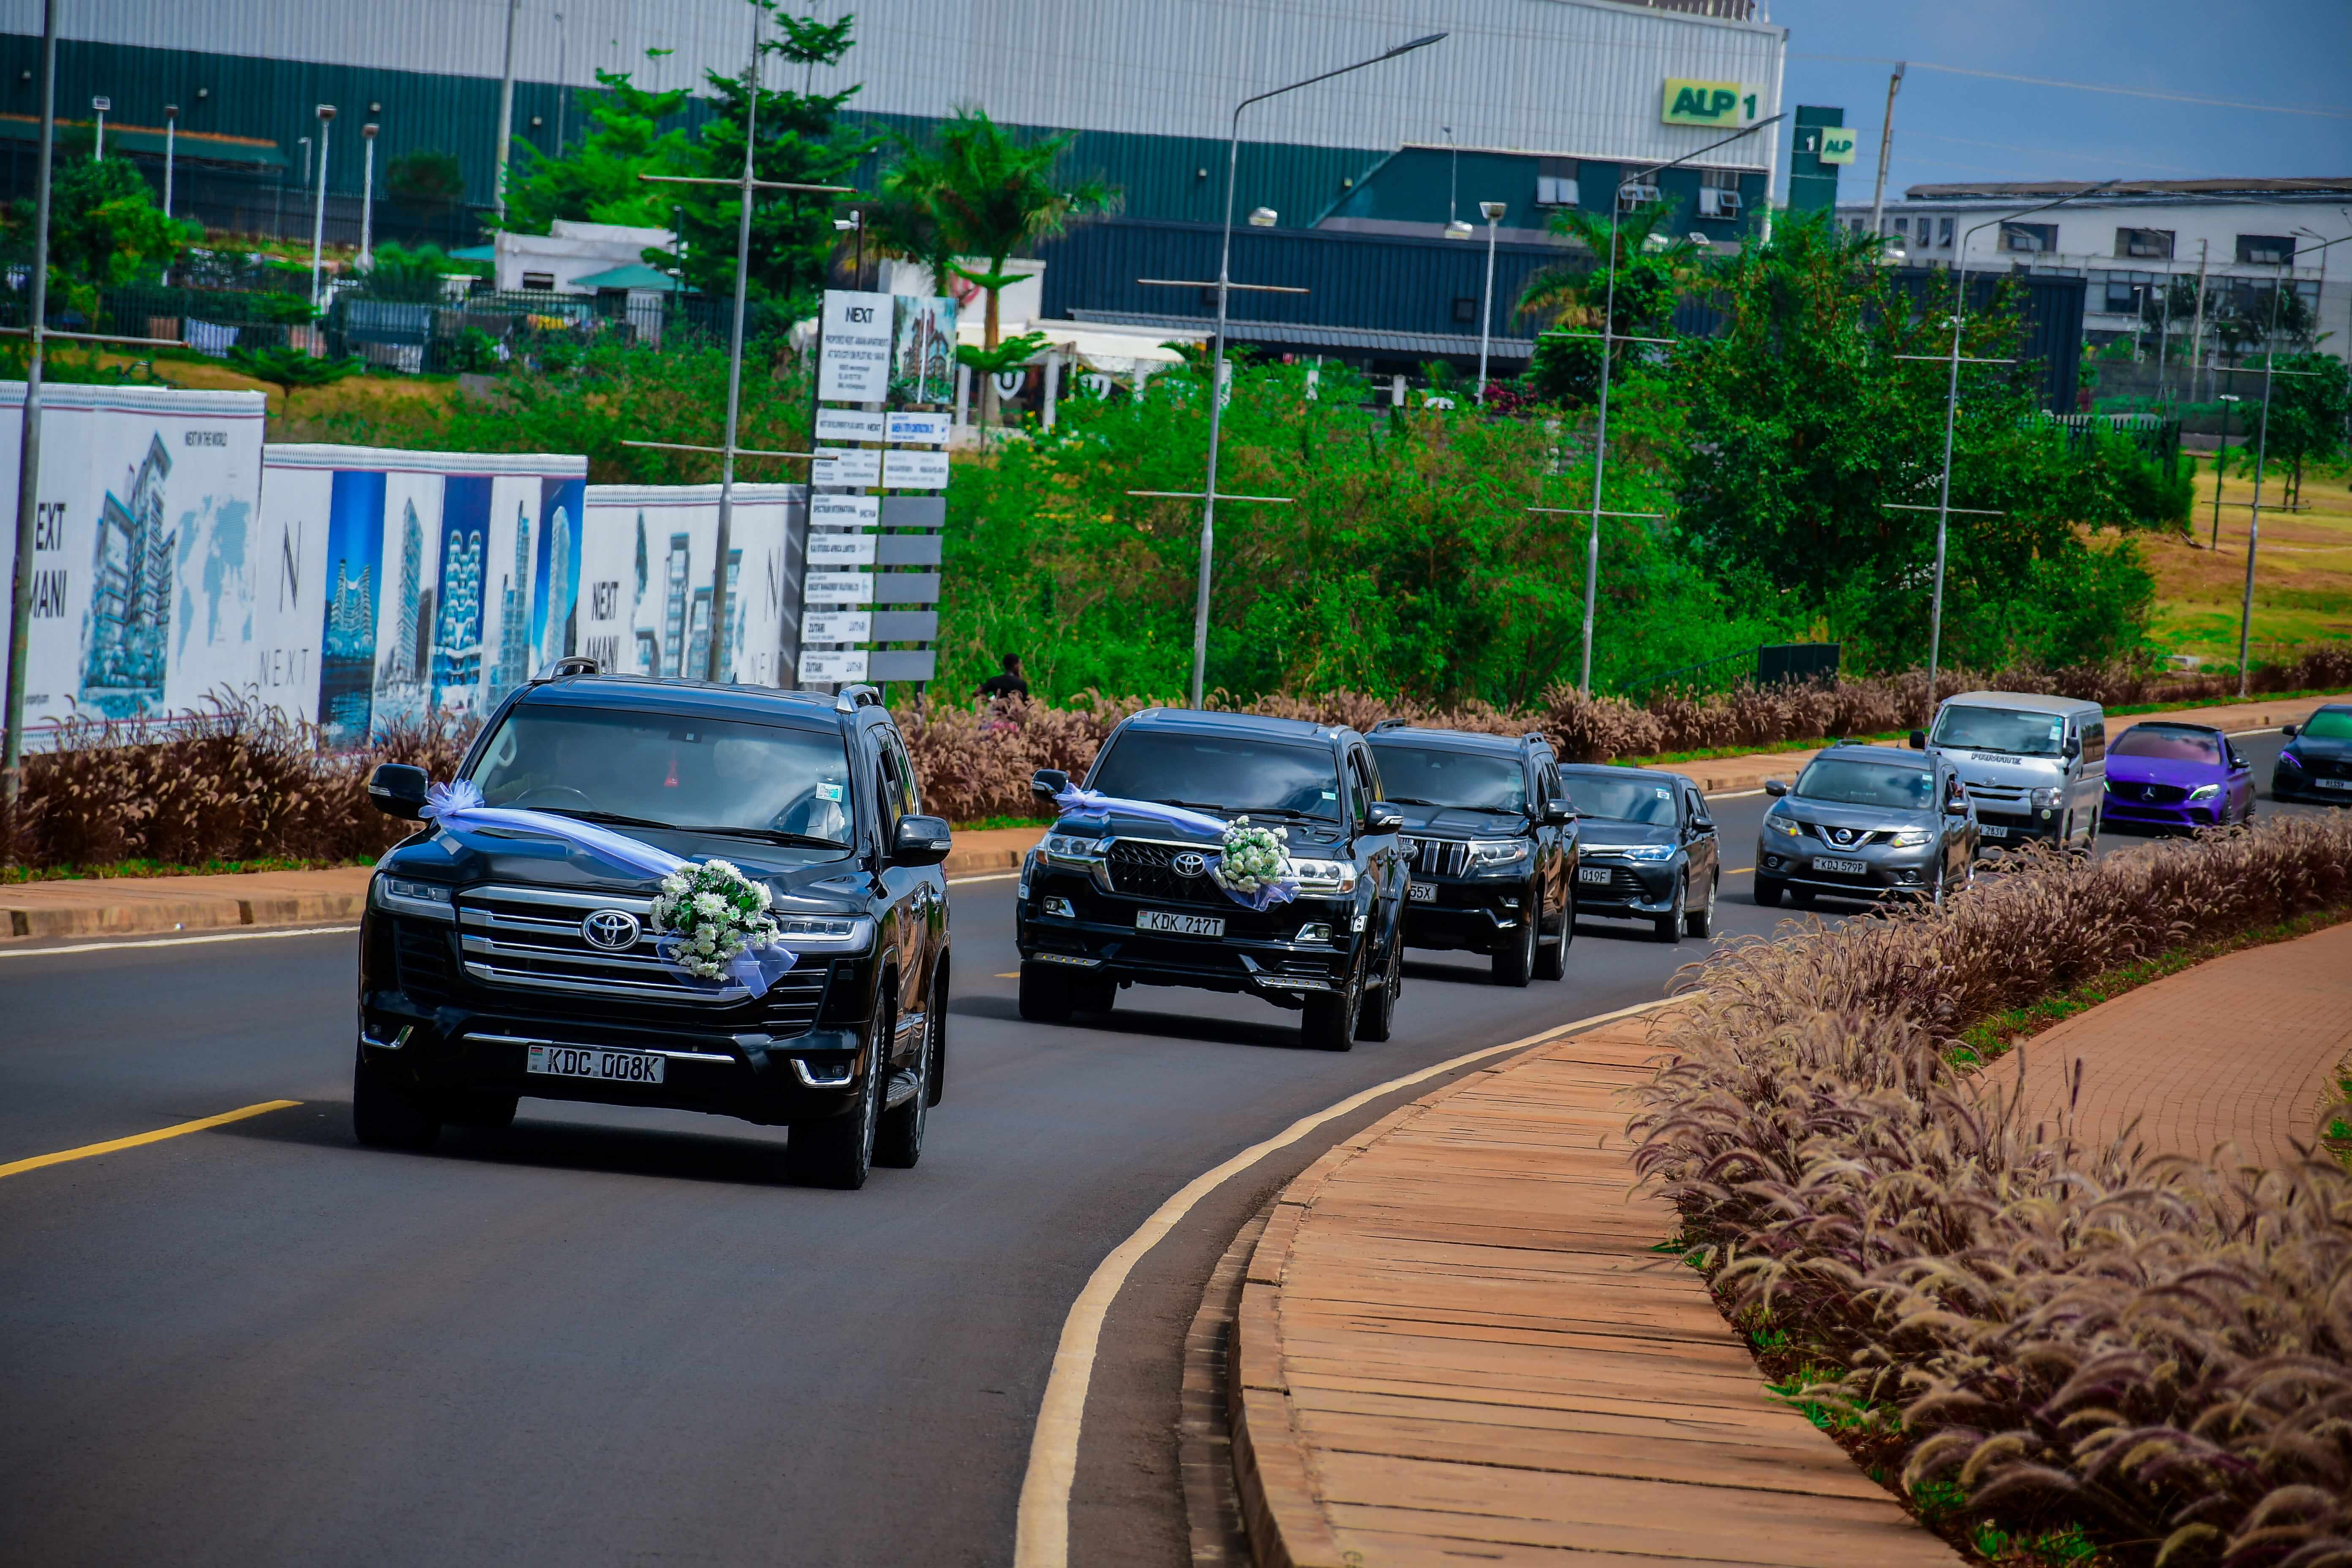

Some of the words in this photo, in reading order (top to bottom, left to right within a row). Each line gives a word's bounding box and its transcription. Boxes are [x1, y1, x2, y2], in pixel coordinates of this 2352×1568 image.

[1670, 86, 1737, 118] ALP
[1743, 93, 1756, 120] 1
[1806, 135, 1815, 152] 1
[1824, 140, 1853, 153] ALP
[845, 307, 874, 324] NEXT
[36, 502, 66, 551] EXT
[280, 520, 302, 613] N
[765, 546, 780, 621] N
[592, 581, 619, 621] NEXT
[260, 648, 309, 687] NEXT
[1971, 753, 2021, 765] PRIVATE
[1582, 870, 1606, 882] 019F
[1821, 859, 1838, 870] KDJ
[1842, 861, 1863, 872] 579P
[1410, 885, 1431, 899] 55X
[1151, 912, 1179, 931] KDK
[1186, 917, 1220, 935] 717T
[548, 1048, 592, 1075] KDC
[602, 1052, 659, 1081] 008K
